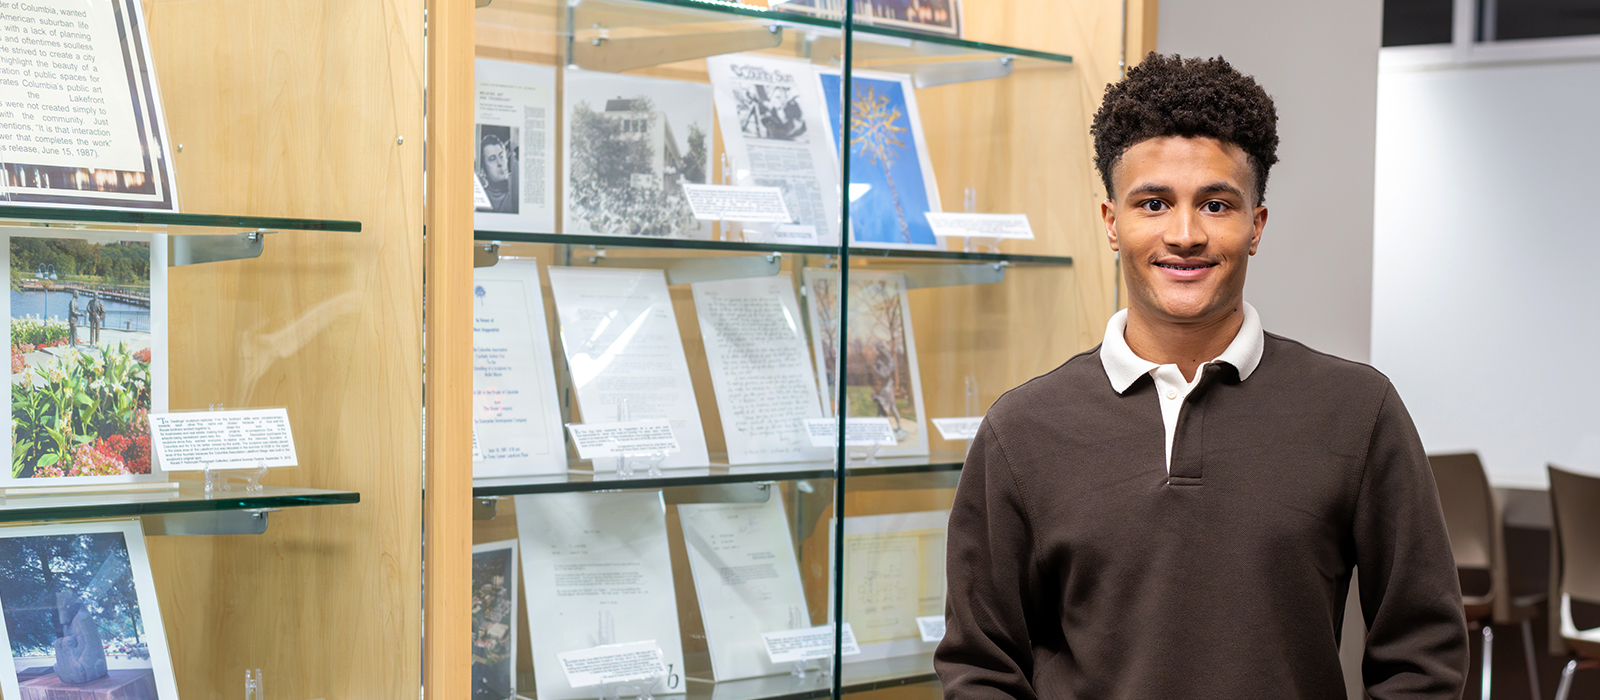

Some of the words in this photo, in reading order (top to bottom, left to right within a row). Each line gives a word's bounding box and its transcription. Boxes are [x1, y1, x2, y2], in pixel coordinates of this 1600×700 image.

[11, 2, 19, 10] of
[59, 9, 87, 18] wanted
[0, 12, 36, 24] American
[39, 18, 75, 28] suburban
[77, 21, 89, 30] life
[4, 24, 20, 33] with
[30, 26, 47, 36] lack
[59, 30, 92, 42] planning
[4, 36, 19, 44] and
[21, 36, 61, 48] oftentimes
[63, 42, 94, 51] soulless
[11, 47, 37, 56] strived
[49, 51, 73, 60] create
[82, 54, 96, 63] city
[0, 56, 33, 68] highlight
[36, 60, 49, 68] the
[52, 61, 78, 72] beauty
[23, 69, 31, 77] of
[34, 71, 57, 80] public
[59, 74, 87, 82] spaces
[89, 74, 100, 83] for
[66, 84, 90, 92] public
[27, 91, 40, 100] the
[68, 94, 105, 104] Lakefront
[41, 104, 70, 112] created
[72, 106, 97, 116] simply
[22, 112, 34, 120] the
[93, 117, 109, 126] Just
[46, 125, 53, 133] is
[54, 126, 70, 134] that
[72, 127, 111, 136] interaction
[16, 133, 32, 142] that
[34, 136, 74, 145] completes
[76, 138, 89, 146] the
[41, 146, 60, 155] June
[668, 664, 679, 689] b
